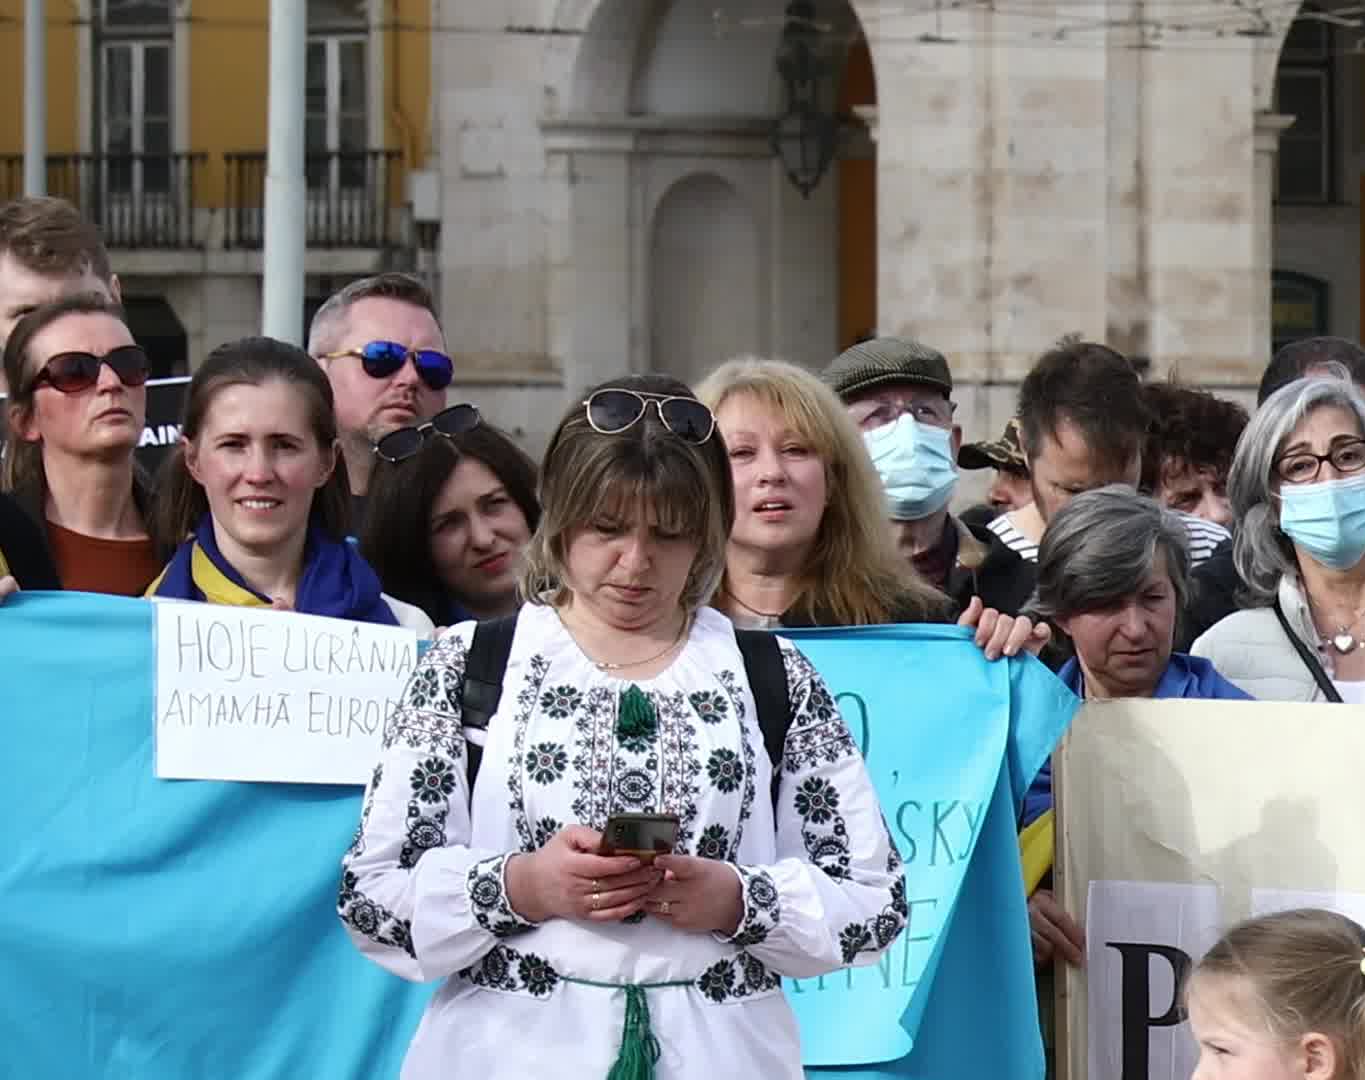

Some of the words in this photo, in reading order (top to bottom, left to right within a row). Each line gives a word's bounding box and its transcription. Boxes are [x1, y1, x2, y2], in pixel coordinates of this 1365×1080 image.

[176, 615, 268, 682] HOJE
[283, 625, 416, 678] UCRÂNIA
[162, 689, 291, 728] AMANHÃ
[307, 691, 402, 743] EUROP
